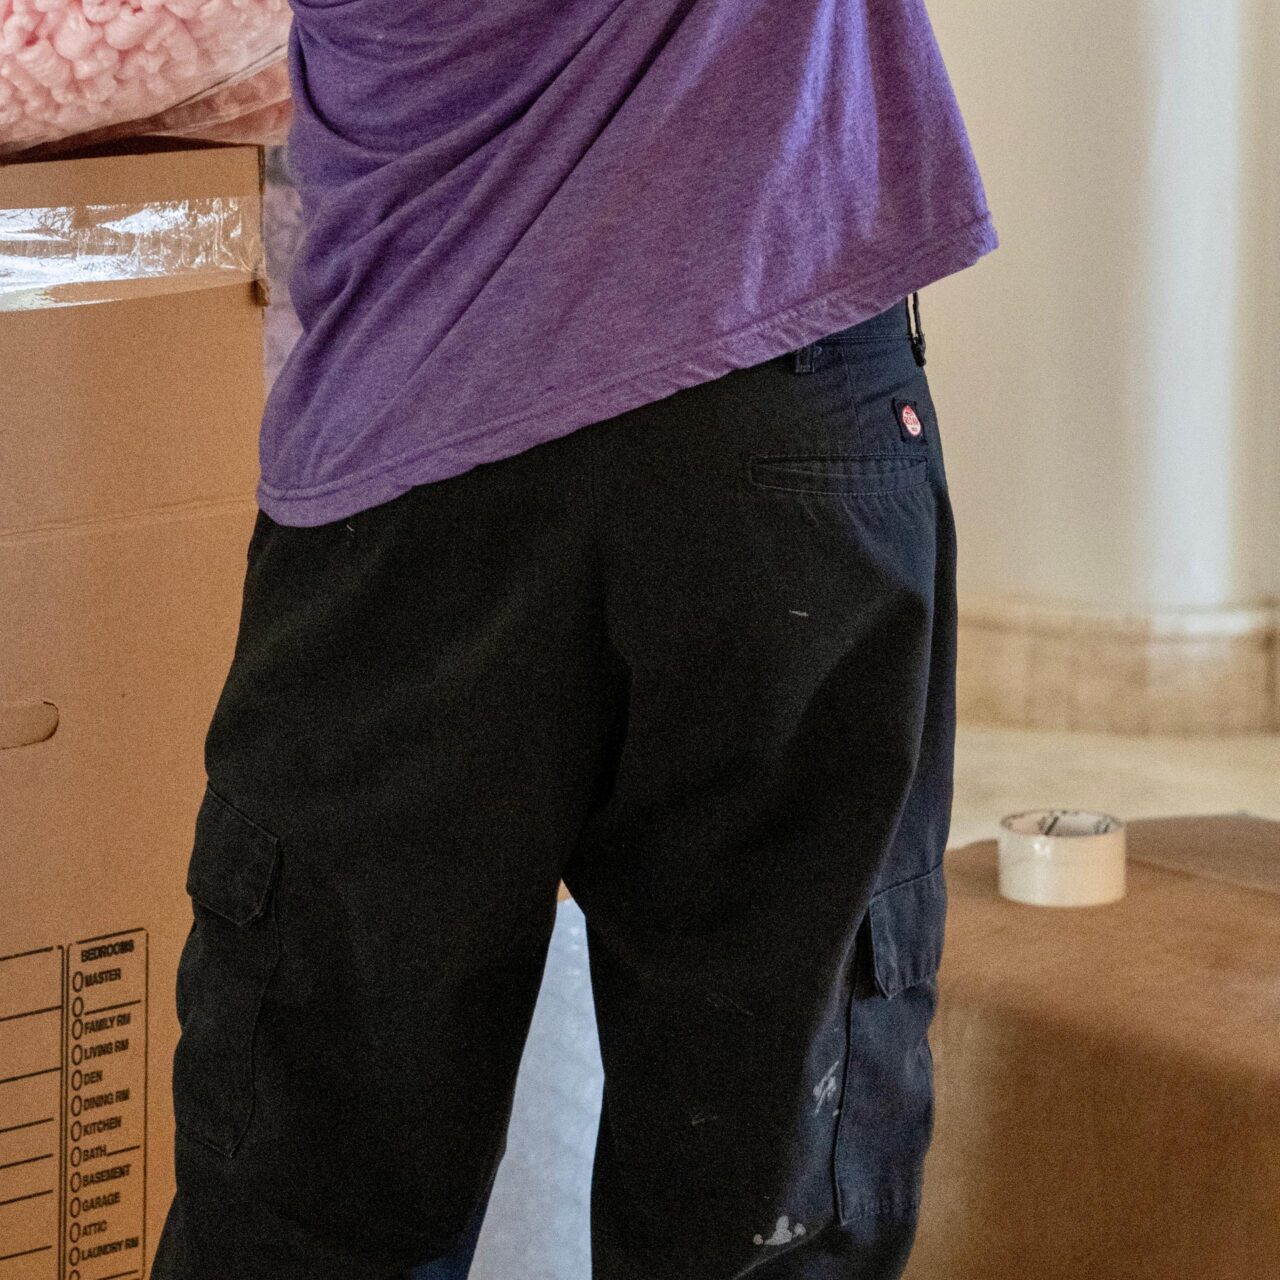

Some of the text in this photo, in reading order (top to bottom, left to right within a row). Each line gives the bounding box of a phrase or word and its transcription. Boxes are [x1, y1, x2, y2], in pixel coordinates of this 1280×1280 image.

[81, 939, 134, 962] BEDROOMS
[84, 968, 121, 987] MASTER
[84, 1015, 116, 1035] FAMILY
[84, 1042, 113, 1060] LIVING
[83, 1070, 103, 1086] DEN
[83, 1092, 114, 1111] DINING
[83, 1116, 122, 1136] KITCHEN
[82, 1145, 107, 1162] BATH
[82, 1163, 131, 1187] BASEMENT
[82, 1192, 120, 1211] GARAGE
[81, 1220, 107, 1237] ATTIC
[81, 1239, 125, 1260] LAUNDRY
